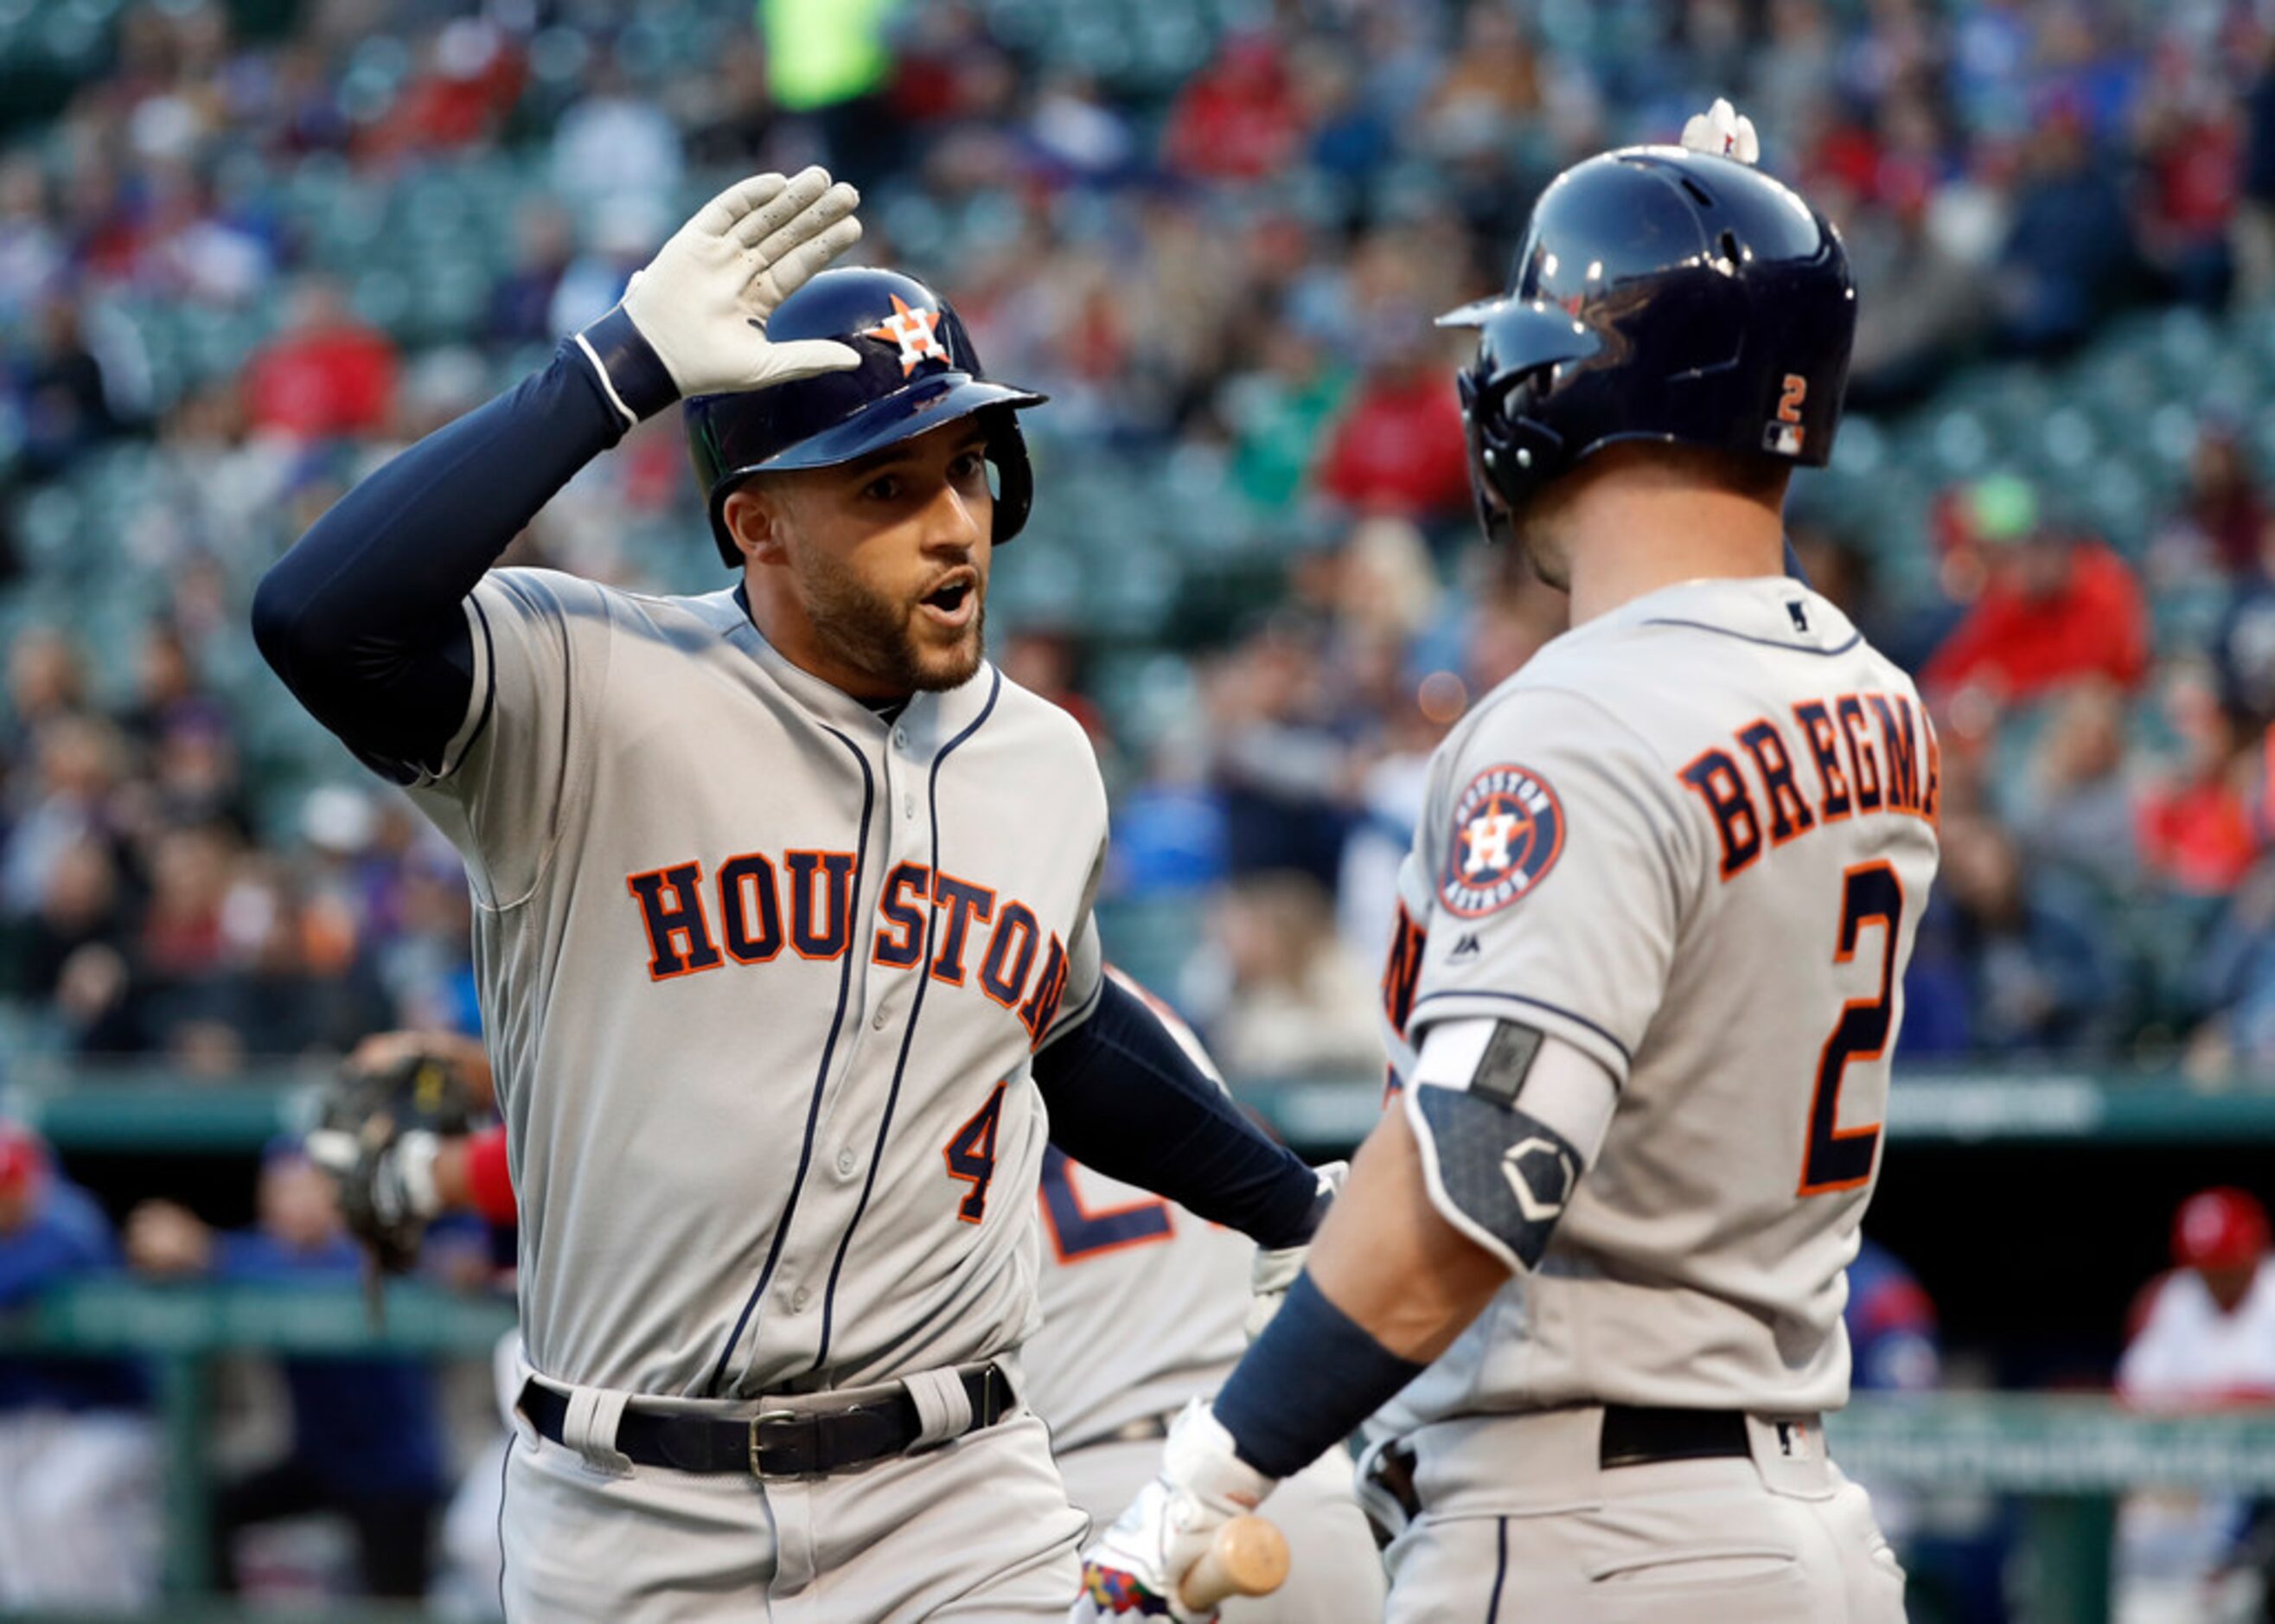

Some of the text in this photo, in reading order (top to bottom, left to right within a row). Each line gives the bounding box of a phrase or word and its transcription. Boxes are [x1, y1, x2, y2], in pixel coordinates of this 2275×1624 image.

[882, 308, 943, 365] H
[1777, 374, 1805, 422] 2
[1456, 769, 1550, 825] HOUSTON
[1444, 867, 1530, 911] ASTROS
[1796, 859, 1904, 1195] 2
[943, 1079, 1007, 1225] 4
